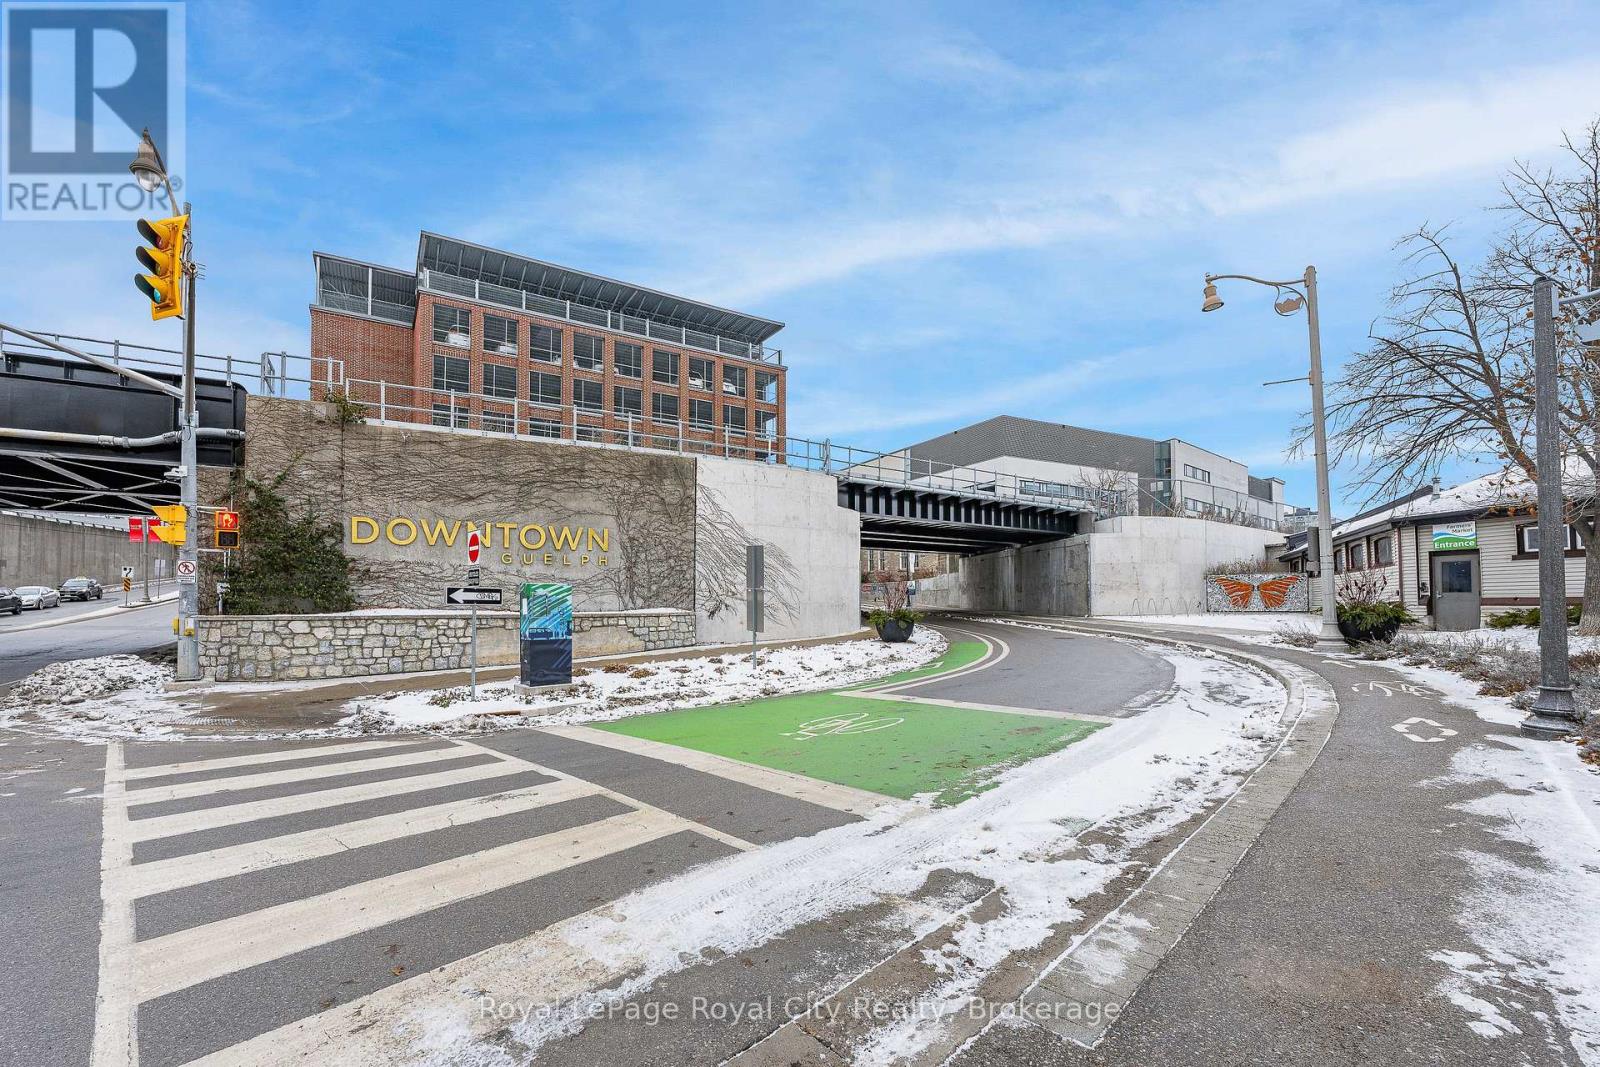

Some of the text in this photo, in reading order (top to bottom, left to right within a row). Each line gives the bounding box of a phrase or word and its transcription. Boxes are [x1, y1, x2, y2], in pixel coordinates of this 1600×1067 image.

[351, 516, 609, 551] DOWNTOWN
[1434, 540, 1475, 549] Entrance
[501, 553, 608, 566] GUELPH
